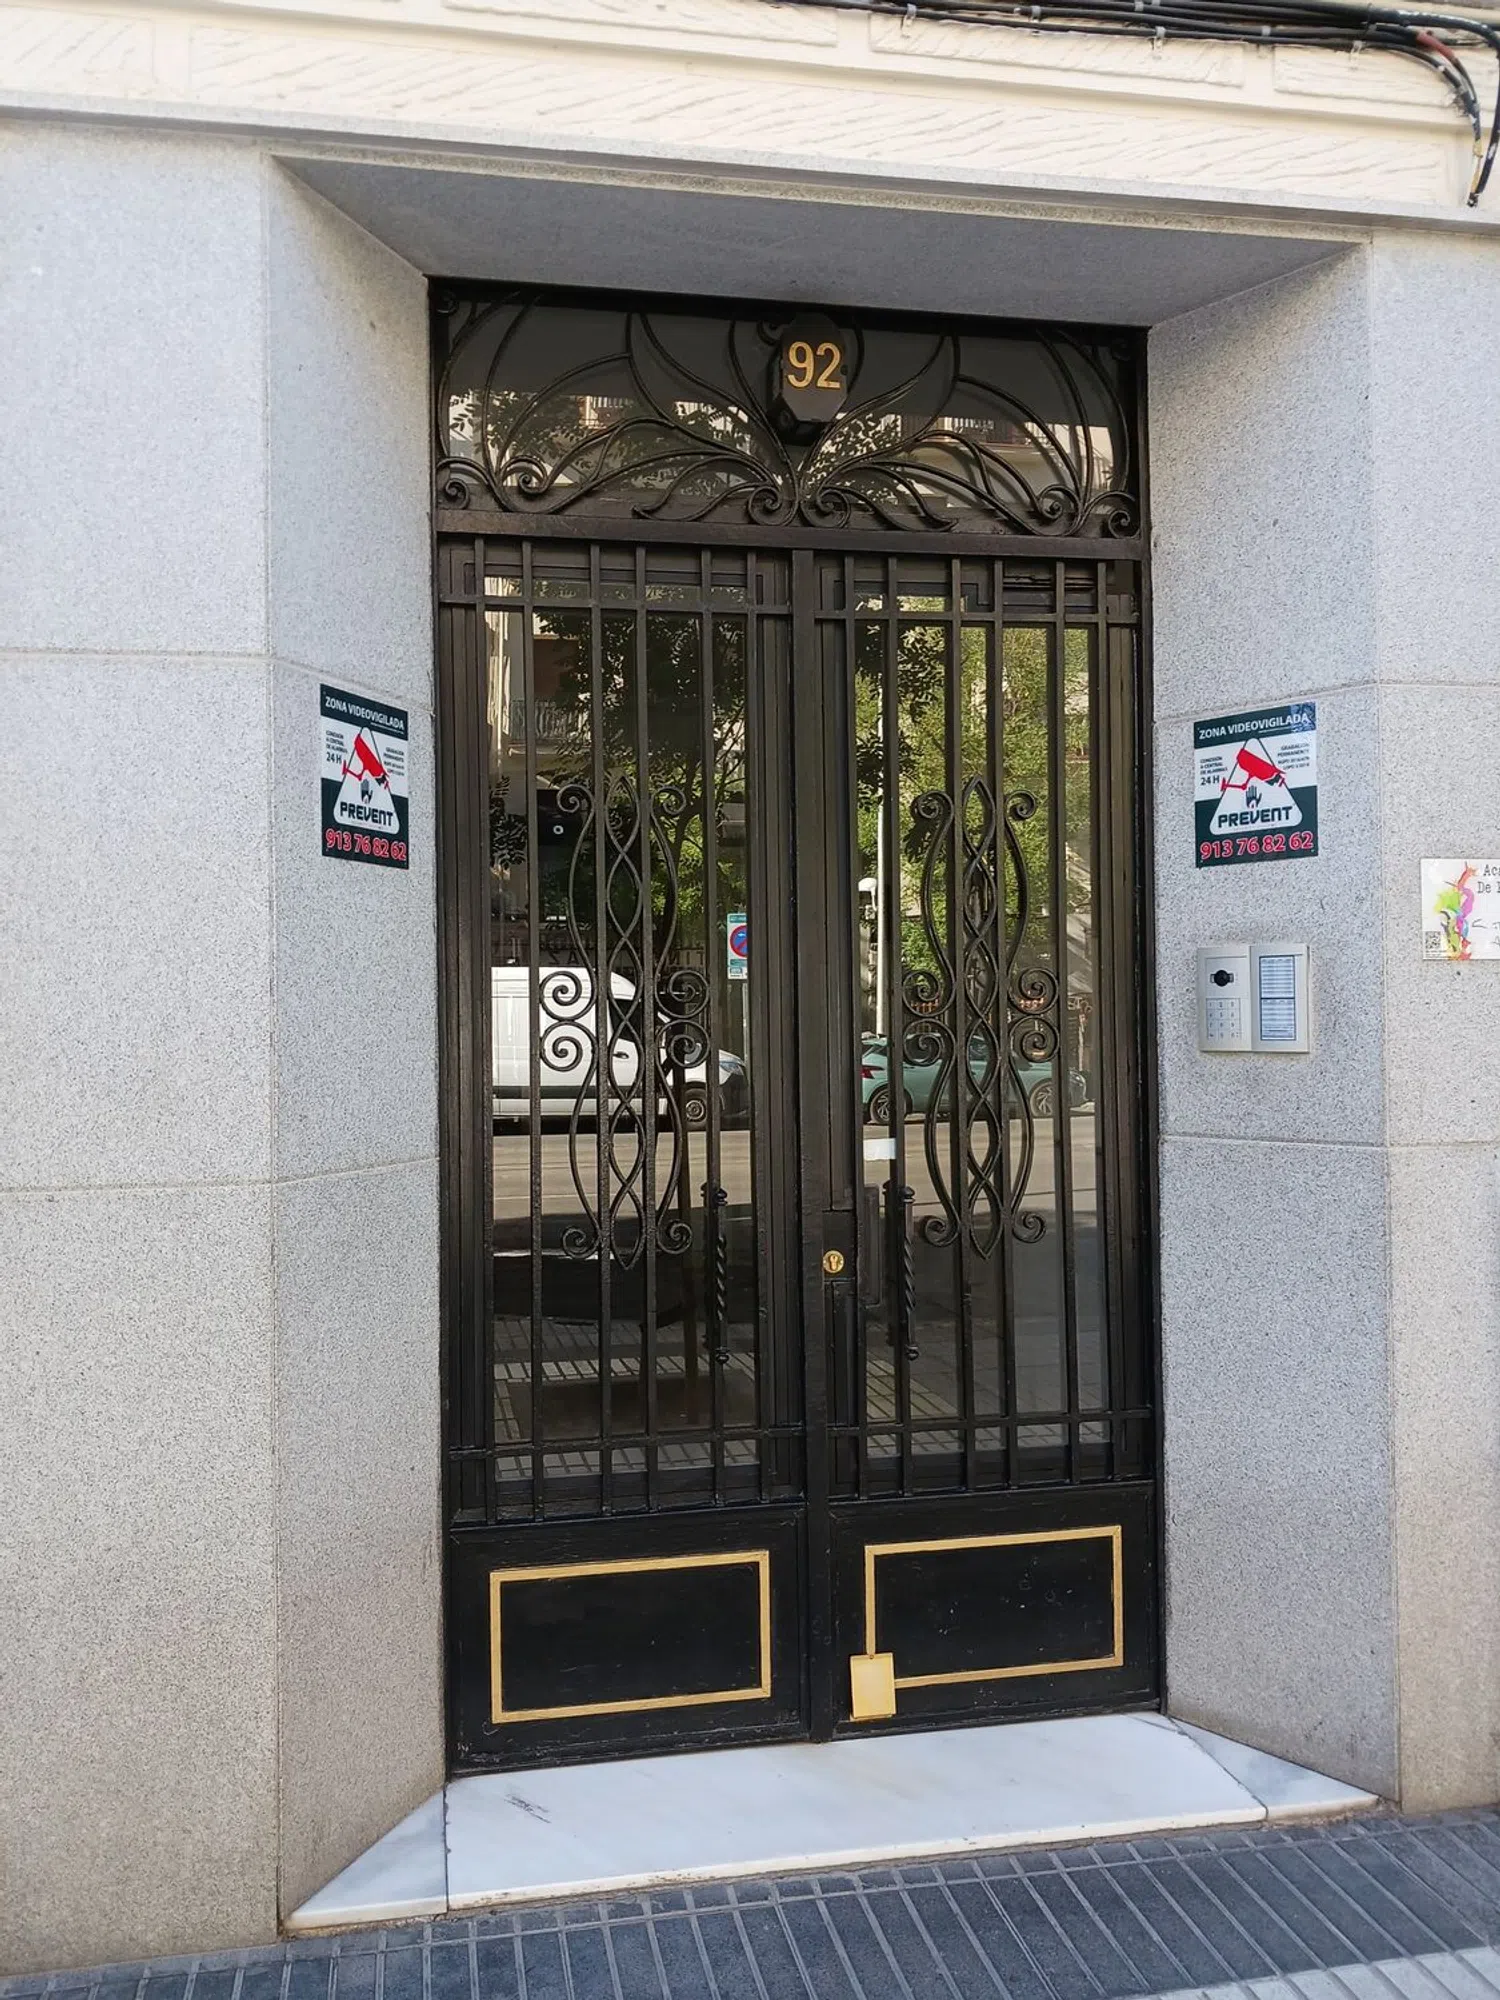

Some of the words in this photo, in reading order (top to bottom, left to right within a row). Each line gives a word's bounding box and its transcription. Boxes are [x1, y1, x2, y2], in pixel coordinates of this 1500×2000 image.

[787, 341, 841, 388] 92
[325, 696, 348, 713] ZONA
[348, 703, 405, 730] VIDEOVIGILADA
[1198, 728, 1227, 740] ZONA
[1227, 713, 1311, 734] VIDEOVIGILADA
[326, 752, 335, 762] 24
[336, 755, 342, 764] H
[1200, 777, 1211, 786] 24
[1212, 775, 1220, 784] H
[340, 801, 393, 827] PREVENT
[1218, 806, 1293, 828] PREVENT
[326, 828, 351, 852] 913
[353, 833, 371, 854] 76
[372, 837, 389, 858] 82
[390, 841, 407, 861] 62
[1200, 839, 1233, 860] 913
[1236, 837, 1260, 856] 76
[1262, 834, 1286, 853] 82
[1289, 830, 1314, 850] 62
[1477, 881, 1491, 893] De
